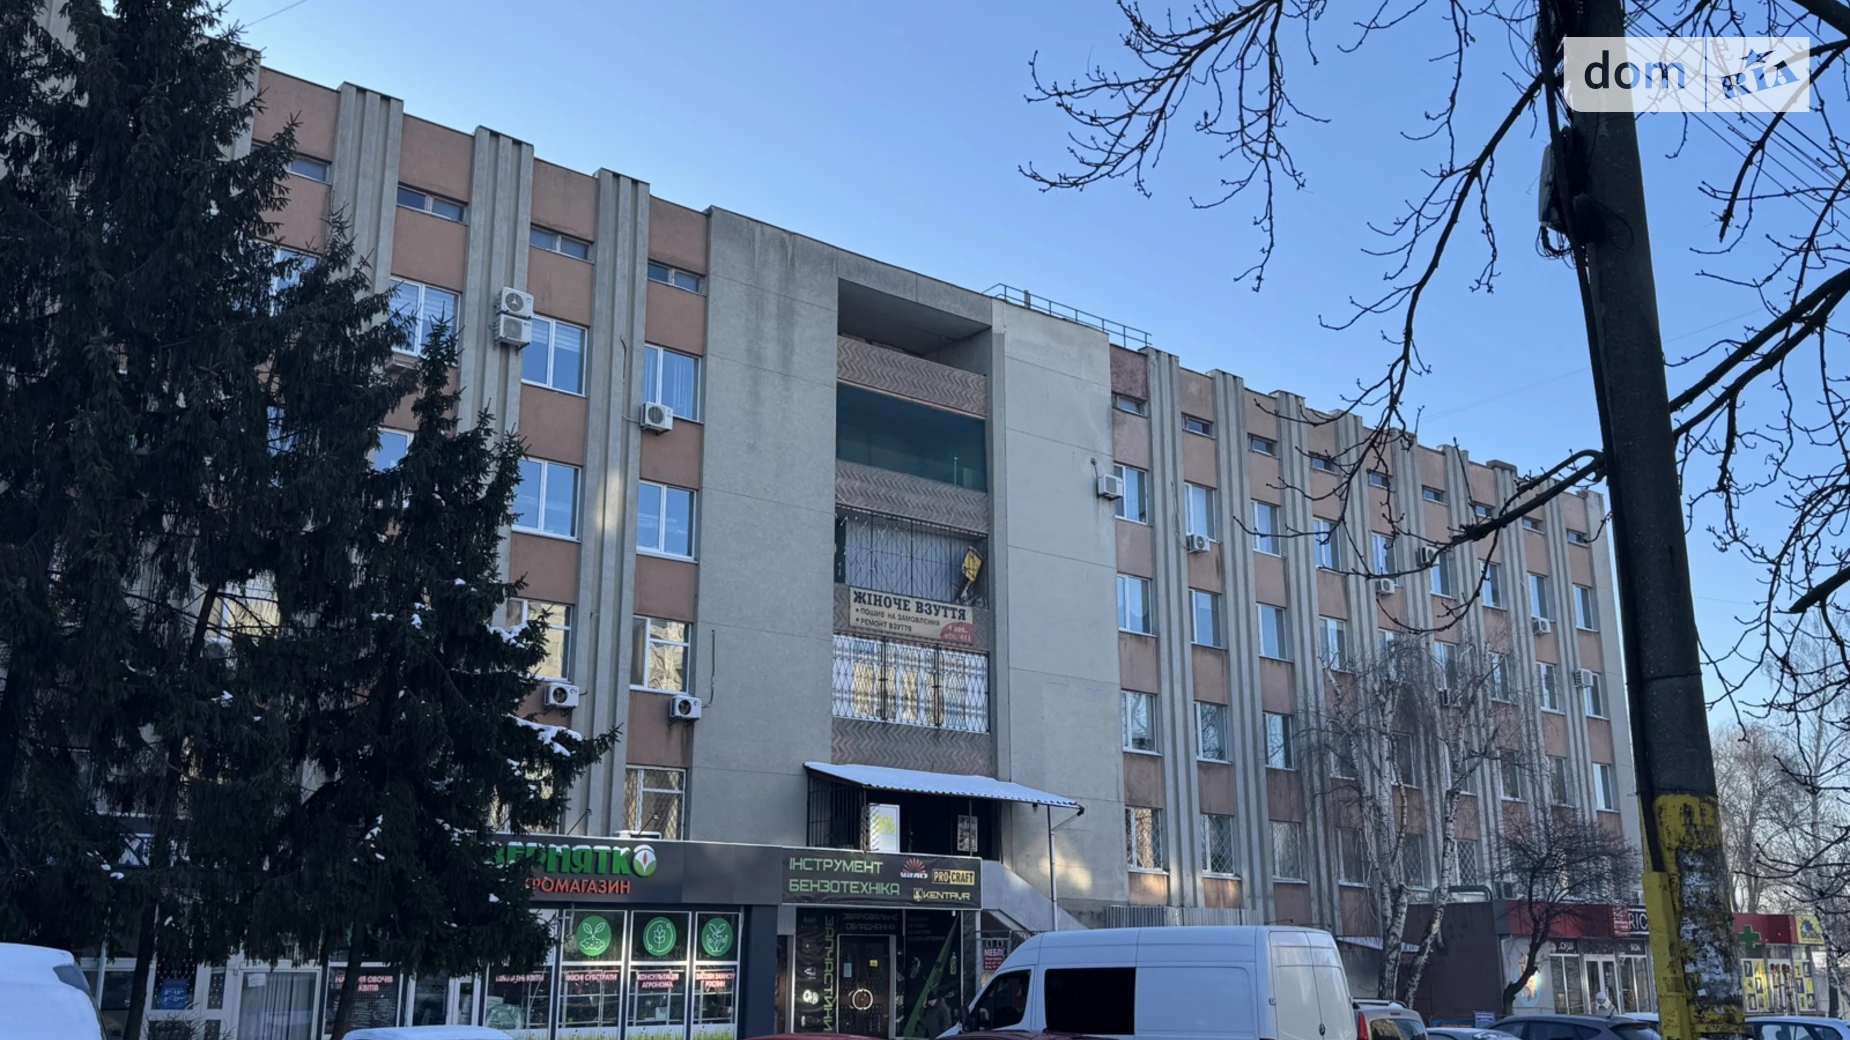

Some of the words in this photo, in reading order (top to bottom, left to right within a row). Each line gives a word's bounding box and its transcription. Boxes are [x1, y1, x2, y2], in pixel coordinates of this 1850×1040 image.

[853, 590, 911, 612] ЖІНОЧЕ
[915, 601, 967, 621] ВЗУТТЯ
[860, 607, 885, 618] ПОШИВ
[897, 613, 941, 627] ЗАМОВЛЕННЯ
[860, 617, 887, 628] РЕМОНТ
[888, 621, 912, 633] ВЗУТТЯ
[789, 857, 884, 874] ІНСТРУМЕНТ
[789, 879, 900, 896] БЕНЗОТЕХНІКА
[823, 915, 834, 1031] ЗАПЧАСТИНИ
